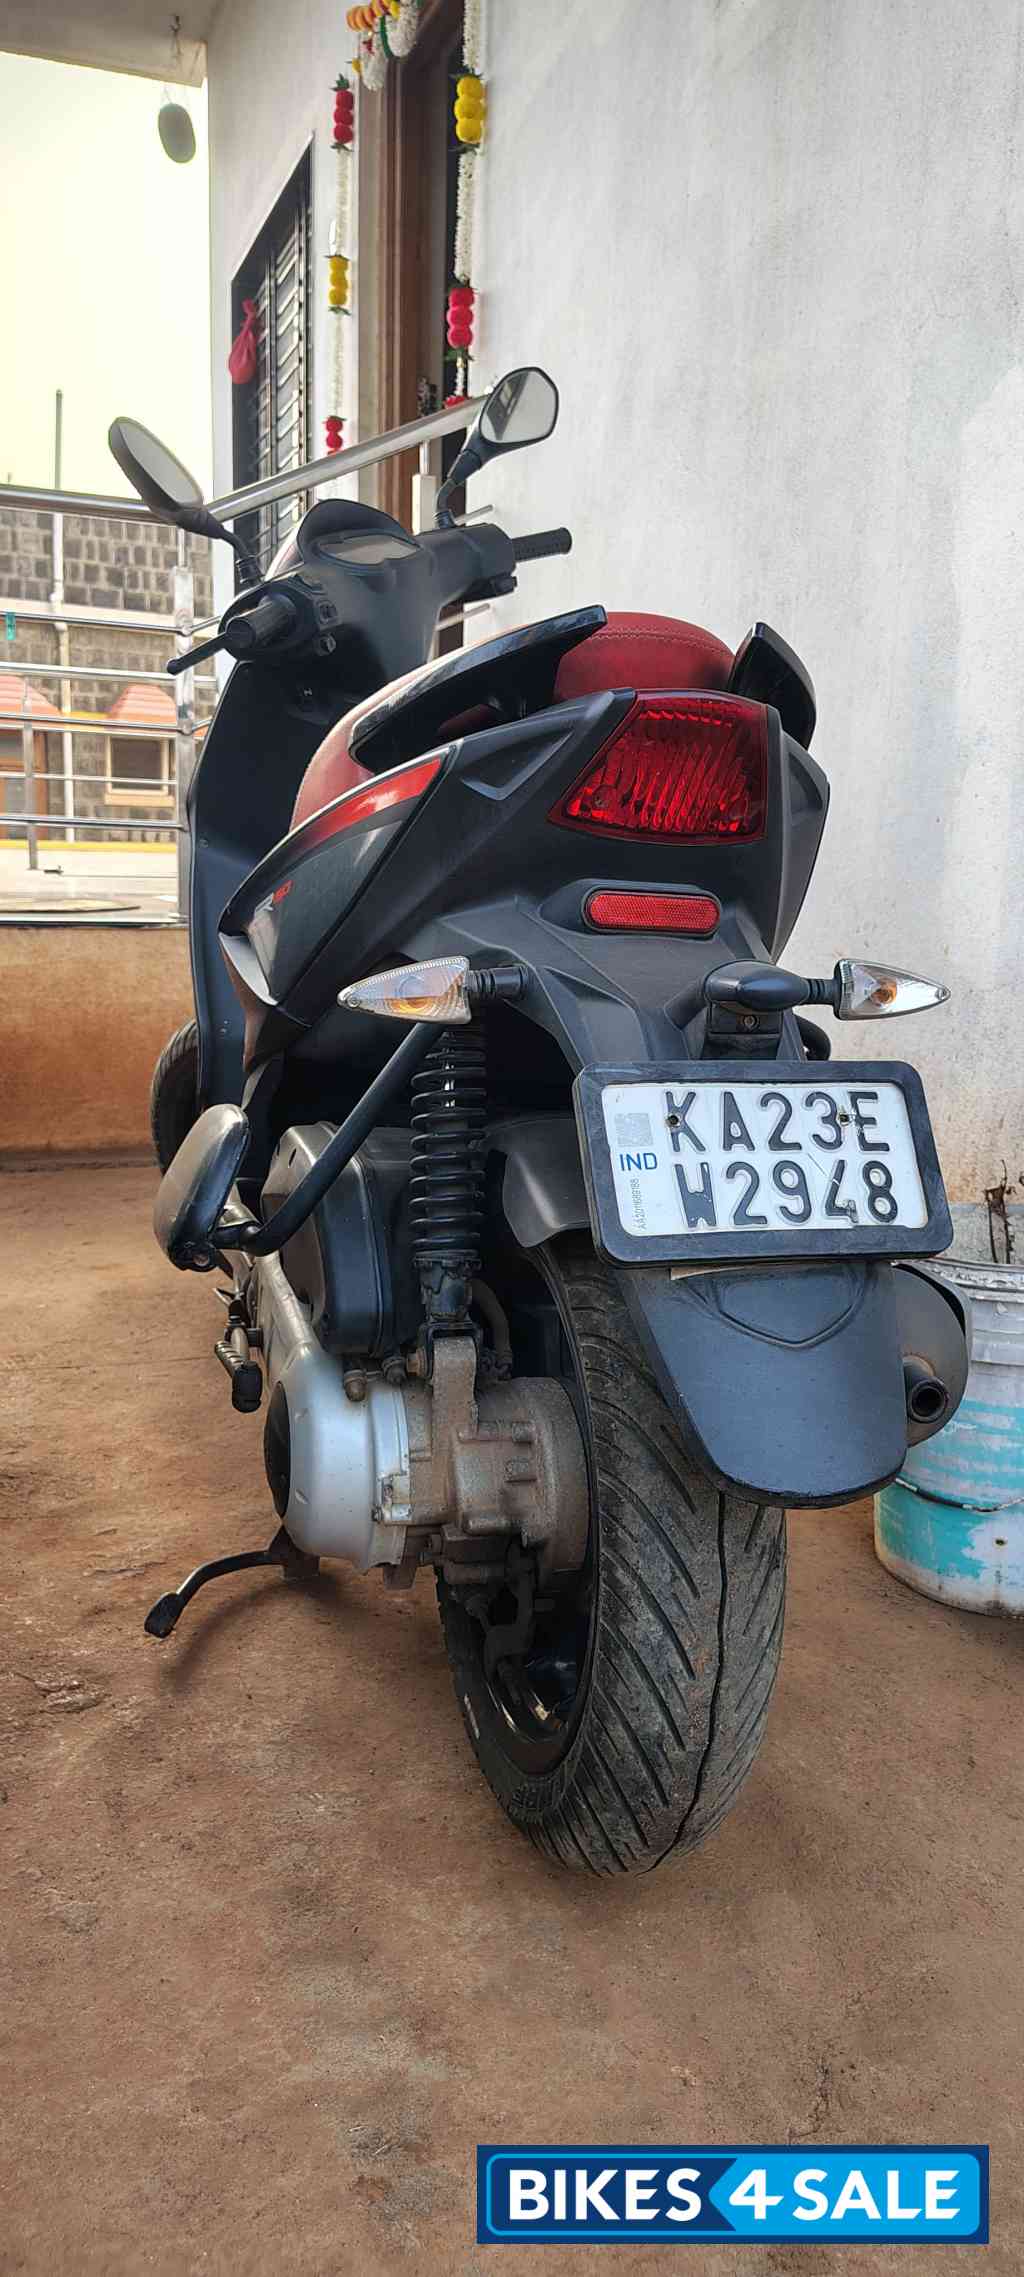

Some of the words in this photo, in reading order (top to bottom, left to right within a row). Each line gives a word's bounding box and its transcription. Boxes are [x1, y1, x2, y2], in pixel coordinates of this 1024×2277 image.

[665, 1091, 890, 1153] KA23E
[620, 1152, 658, 1172] IND
[674, 1159, 899, 1228] W2948
